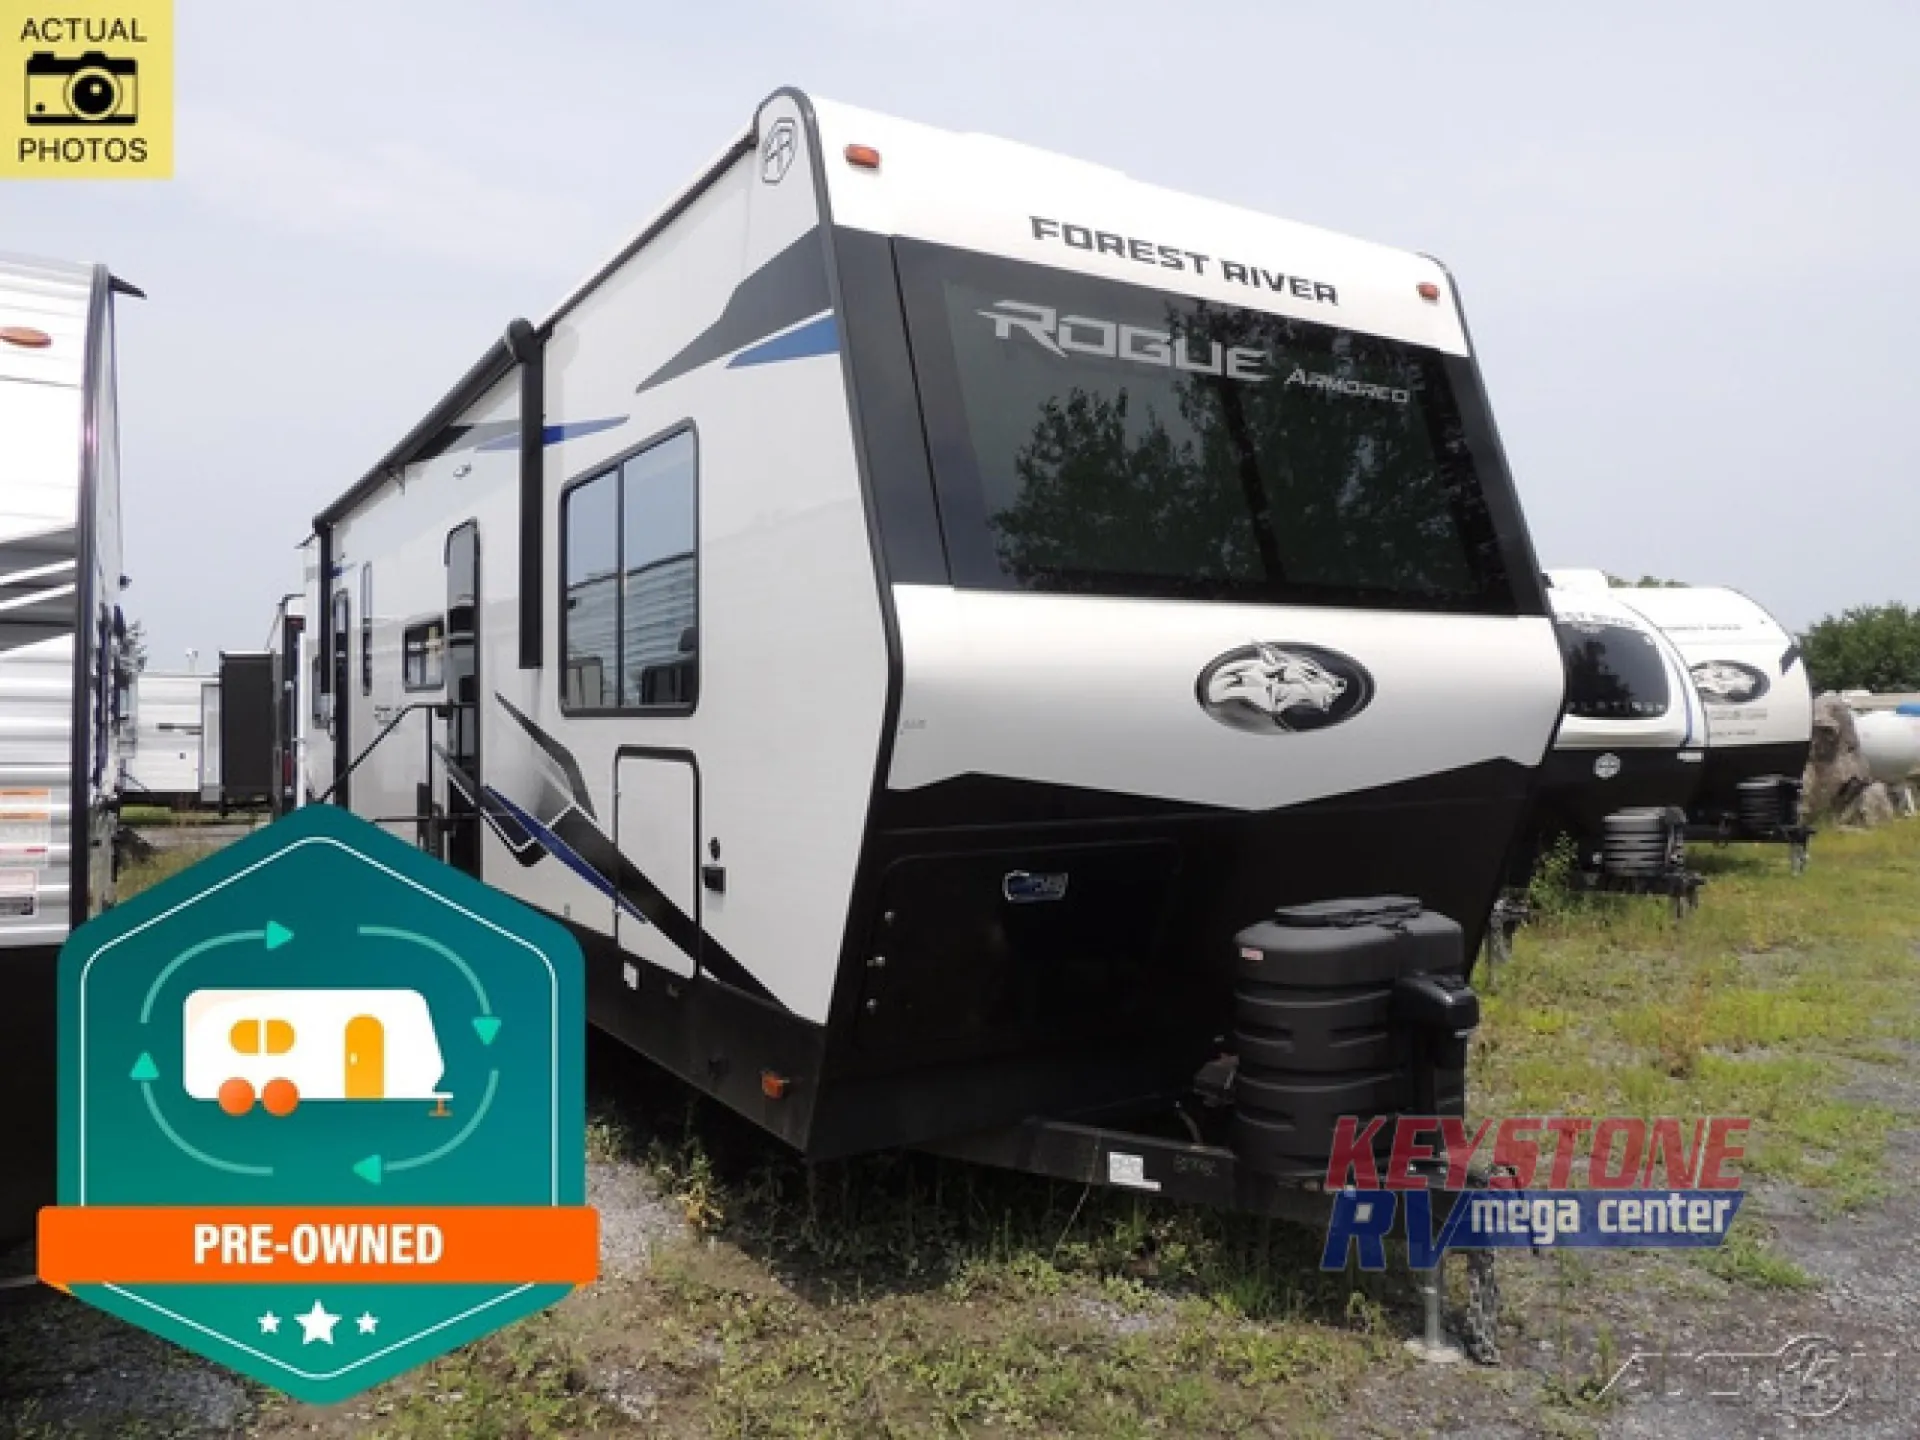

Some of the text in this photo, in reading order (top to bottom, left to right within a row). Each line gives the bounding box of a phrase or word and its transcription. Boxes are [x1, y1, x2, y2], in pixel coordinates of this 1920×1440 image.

[1029, 215, 1339, 306] FOREST RIVER
[977, 300, 1271, 383] ROGUE
